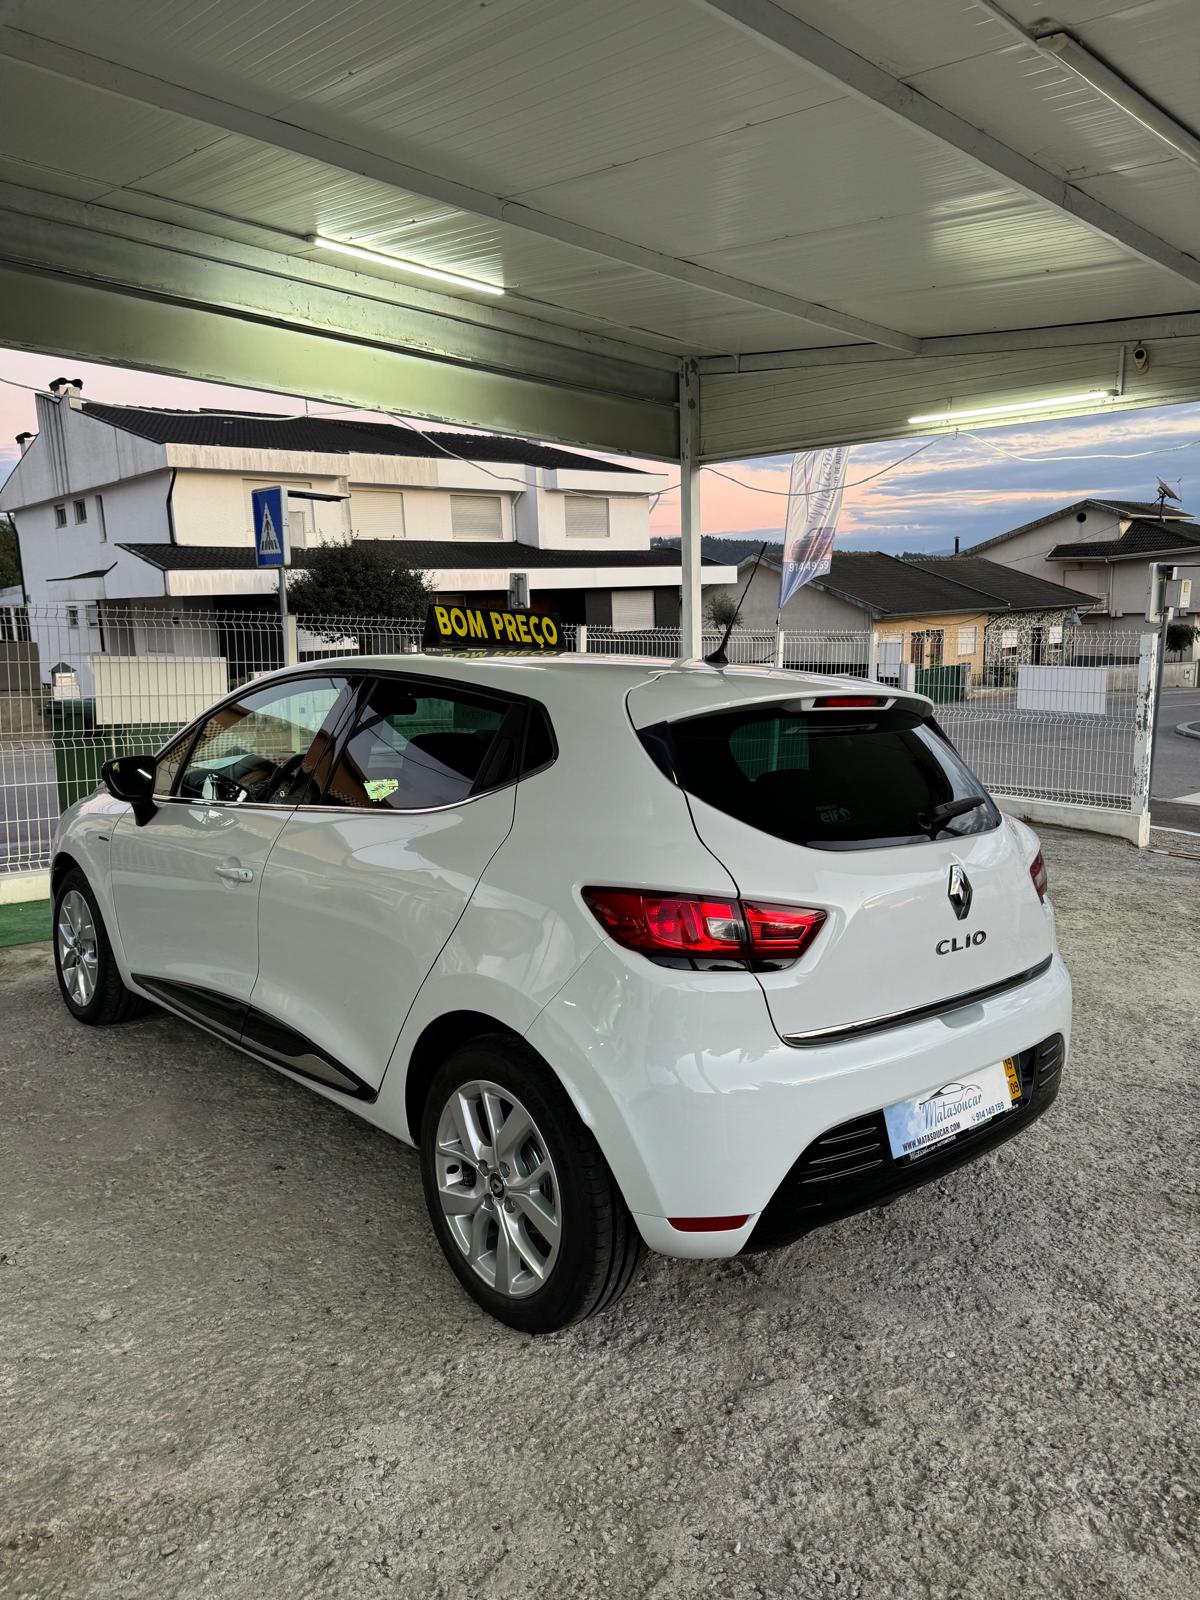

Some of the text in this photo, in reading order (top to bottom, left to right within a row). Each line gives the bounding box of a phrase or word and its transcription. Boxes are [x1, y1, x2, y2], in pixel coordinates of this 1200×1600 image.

[434, 606, 558, 648] BOM PREÇO
[935, 930, 987, 955] CLIO
[1010, 1081, 1020, 1094] 09
[919, 1093, 983, 1130] Matasoucar
[902, 1122, 961, 1151] WWW.MATASOUCAR.COM
